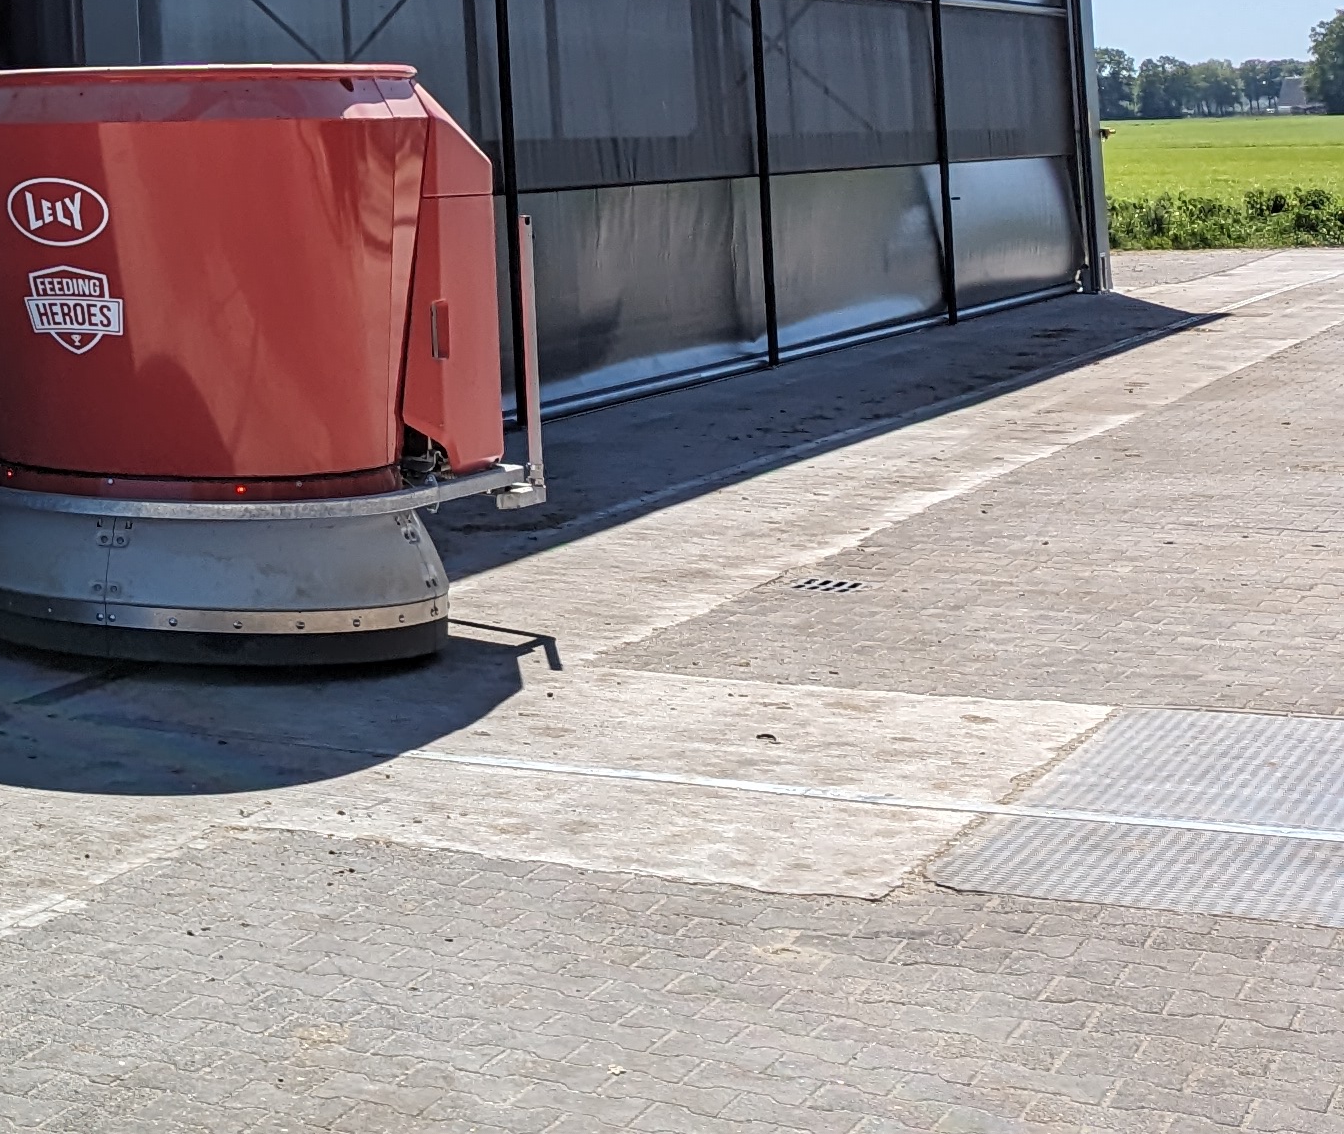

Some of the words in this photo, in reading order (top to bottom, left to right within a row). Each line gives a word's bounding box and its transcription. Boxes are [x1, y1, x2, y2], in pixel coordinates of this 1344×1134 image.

[25, 191, 83, 231] LELY
[36, 278, 100, 296] FEEDING
[35, 302, 112, 328] HEROES
